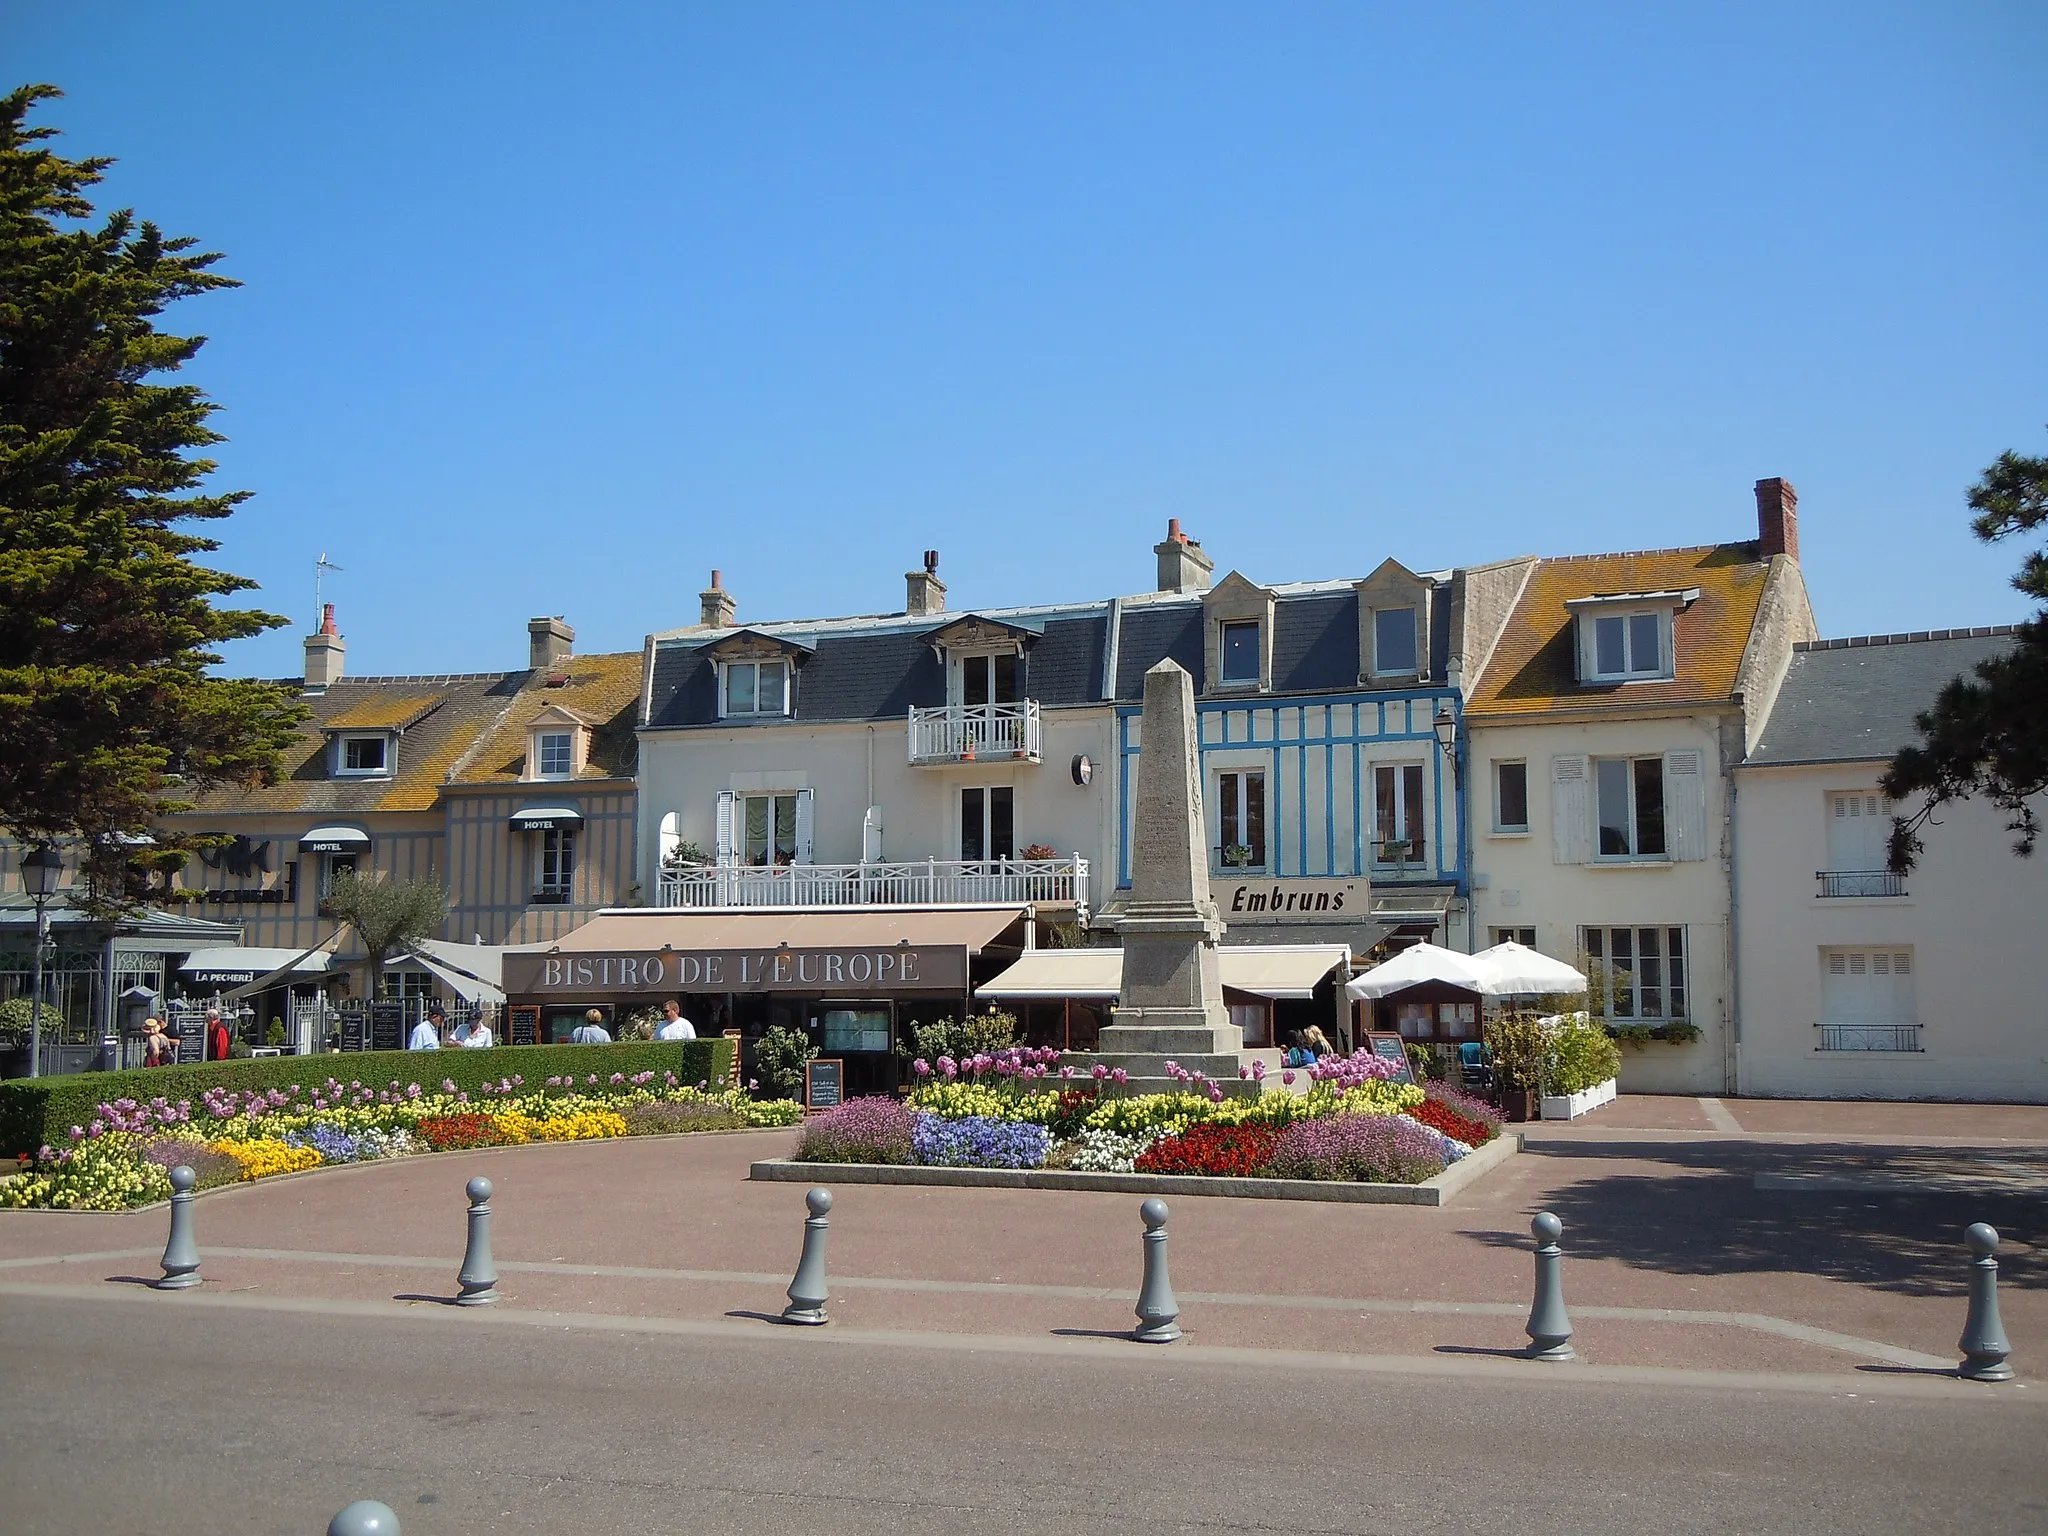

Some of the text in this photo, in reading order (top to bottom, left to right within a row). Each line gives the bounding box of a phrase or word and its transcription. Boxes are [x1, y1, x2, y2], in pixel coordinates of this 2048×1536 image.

[524, 820, 555, 829] HOTEL
[313, 843, 342, 851] HOTEL
[543, 952, 921, 987] BISTRO DE L'EUROPE
[195, 971, 208, 982] LA
